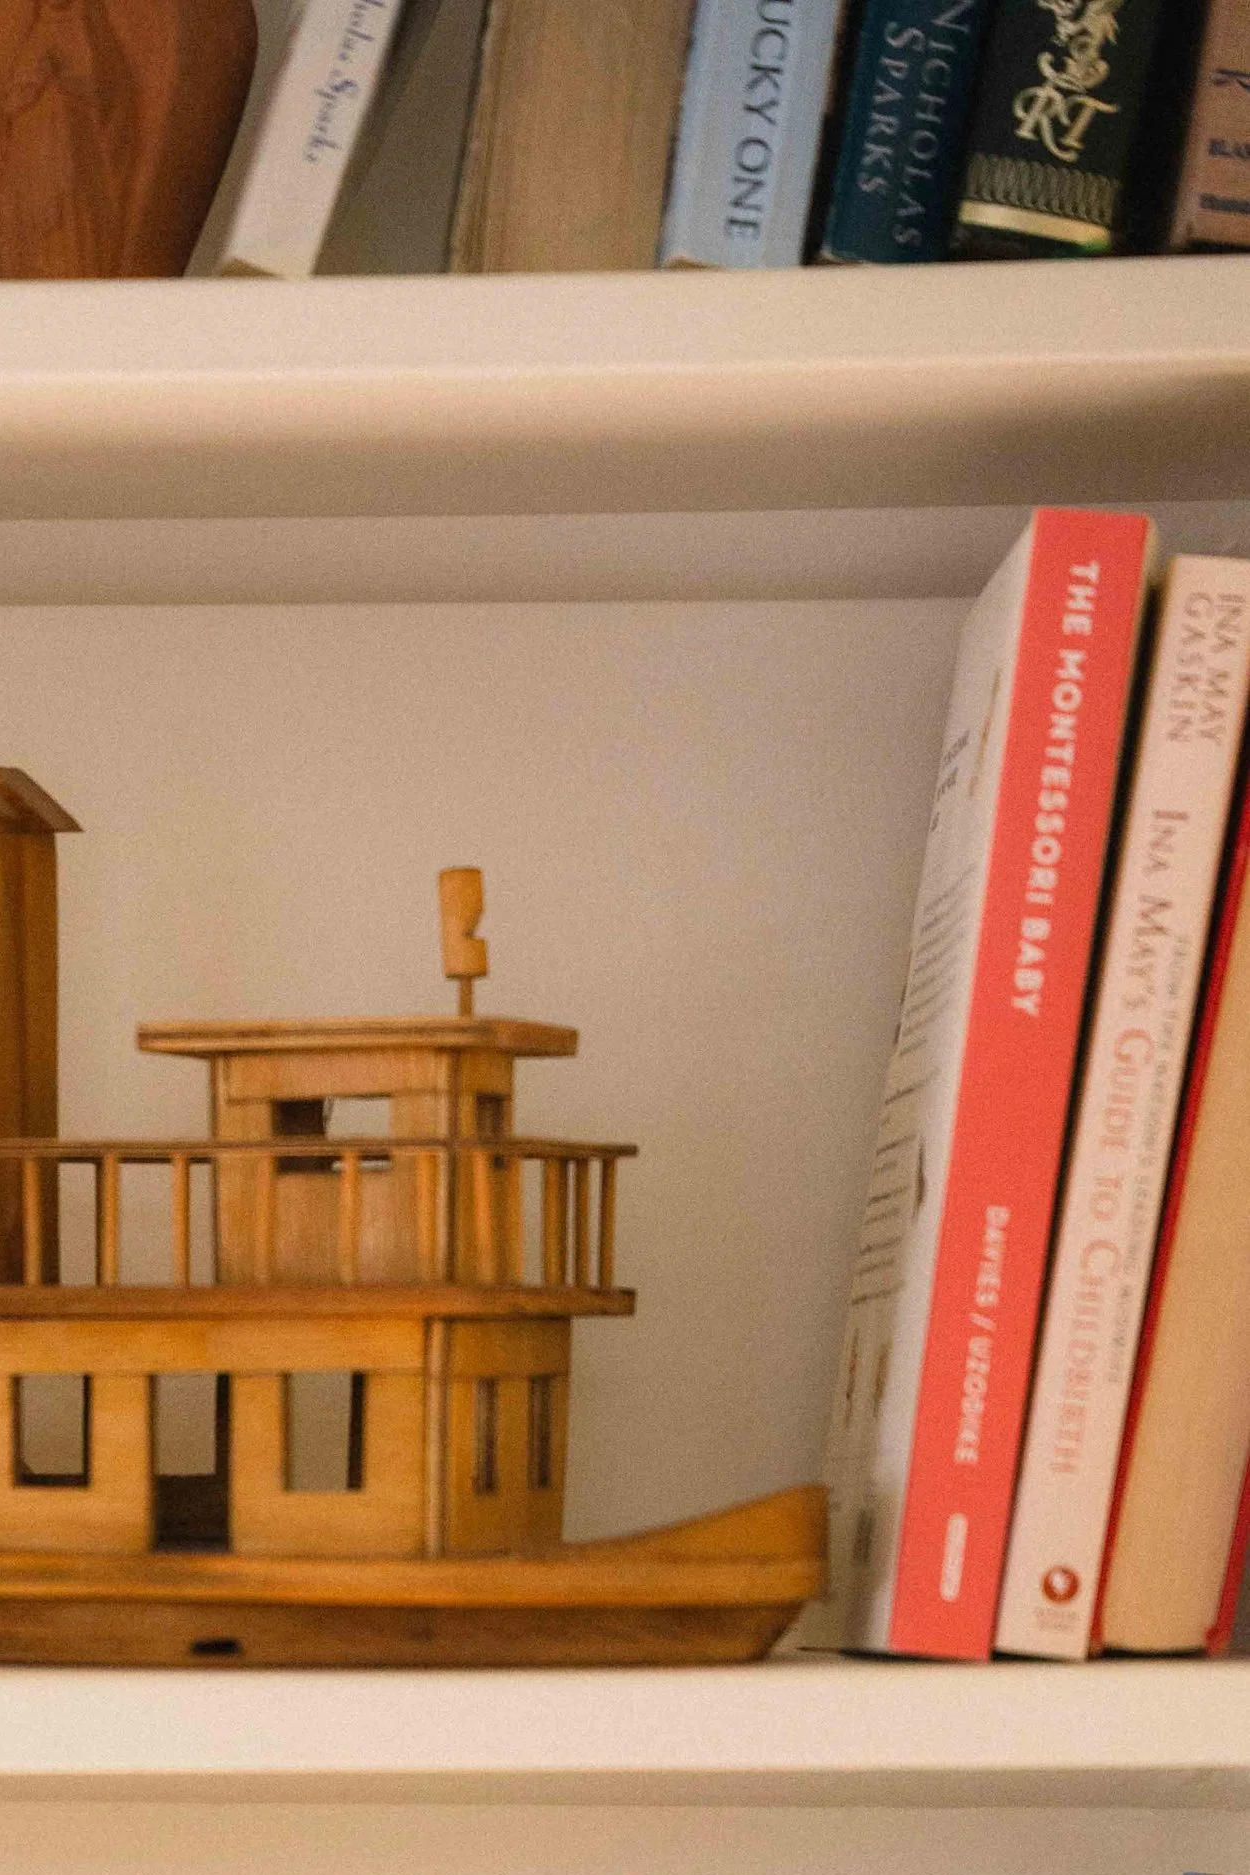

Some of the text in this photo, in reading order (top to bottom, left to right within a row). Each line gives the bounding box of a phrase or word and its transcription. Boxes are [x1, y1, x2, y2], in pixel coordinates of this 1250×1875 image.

[305, 69, 357, 162] Sparks
[859, 24, 924, 197] SPARKS
[725, 137, 772, 243] ONE
[1168, 591, 1214, 743] GASKIN
[1200, 591, 1248, 748] INA MAY
[1010, 560, 1099, 1017] THE MONTESSORI BABY
[1142, 808, 1190, 874] INA
[1088, 1176, 1124, 1223] TO
[974, 1204, 1011, 1310] DAVIES
